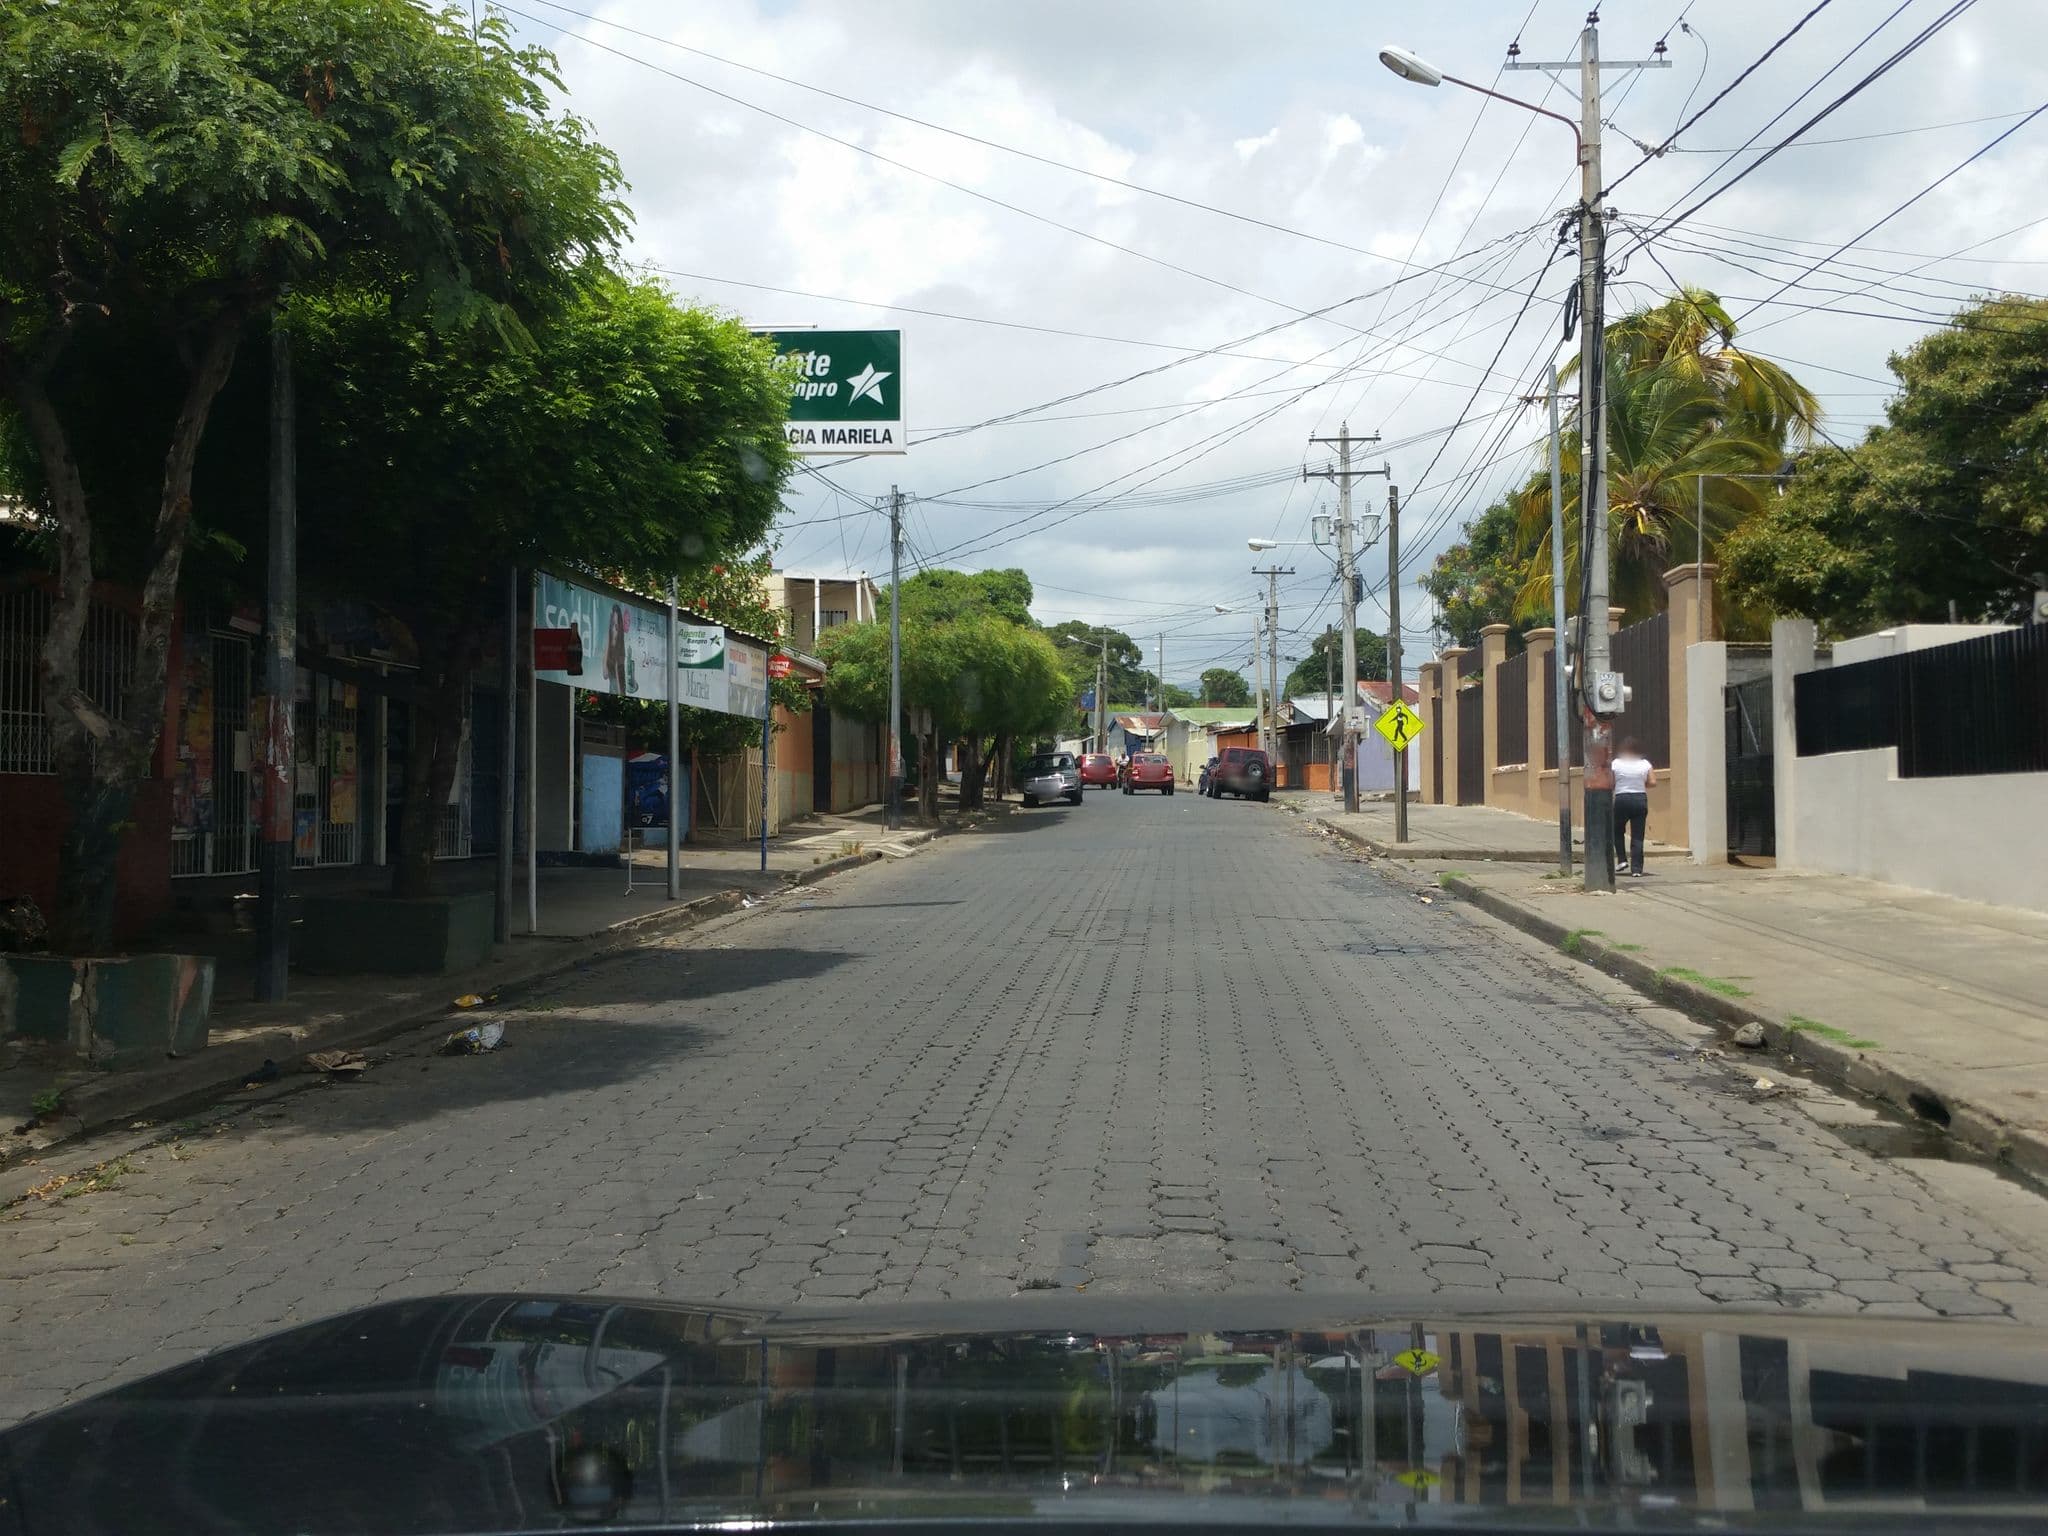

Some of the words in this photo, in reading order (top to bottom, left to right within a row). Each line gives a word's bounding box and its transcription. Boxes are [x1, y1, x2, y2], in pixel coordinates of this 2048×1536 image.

[770, 351, 831, 377] ente
[783, 428, 816, 445] CIA
[822, 428, 894, 445] MARIELA
